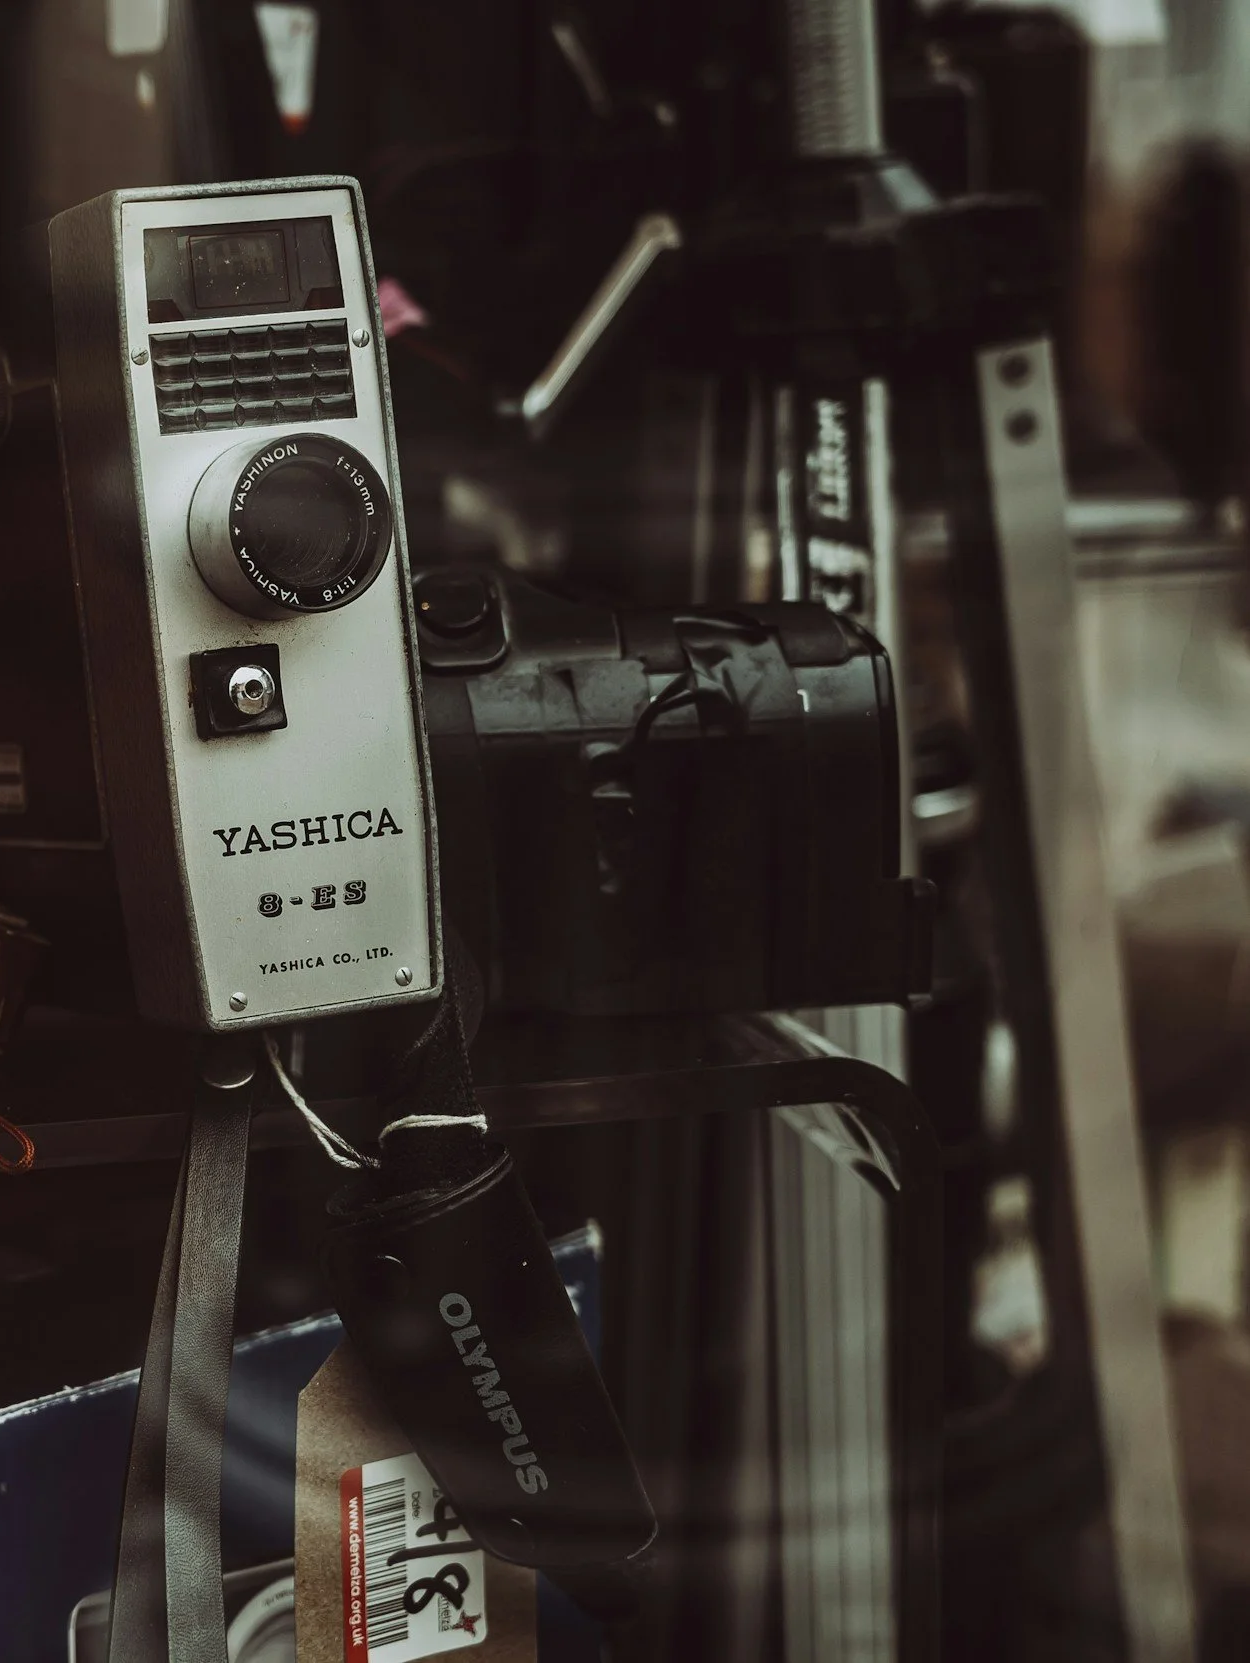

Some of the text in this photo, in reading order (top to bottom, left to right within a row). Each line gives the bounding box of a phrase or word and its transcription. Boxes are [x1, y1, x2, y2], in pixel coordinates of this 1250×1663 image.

[234, 443, 299, 512] YASHINON
[336, 456, 375, 516] f=13mm
[239, 547, 300, 605] YASHICA
[213, 807, 404, 857] YASHICA
[259, 946, 394, 975] YASHICA CO., LTD.
[438, 1291, 549, 1495] OLYMPUS
[348, 1496, 363, 1648] www.demelza.org.uk
